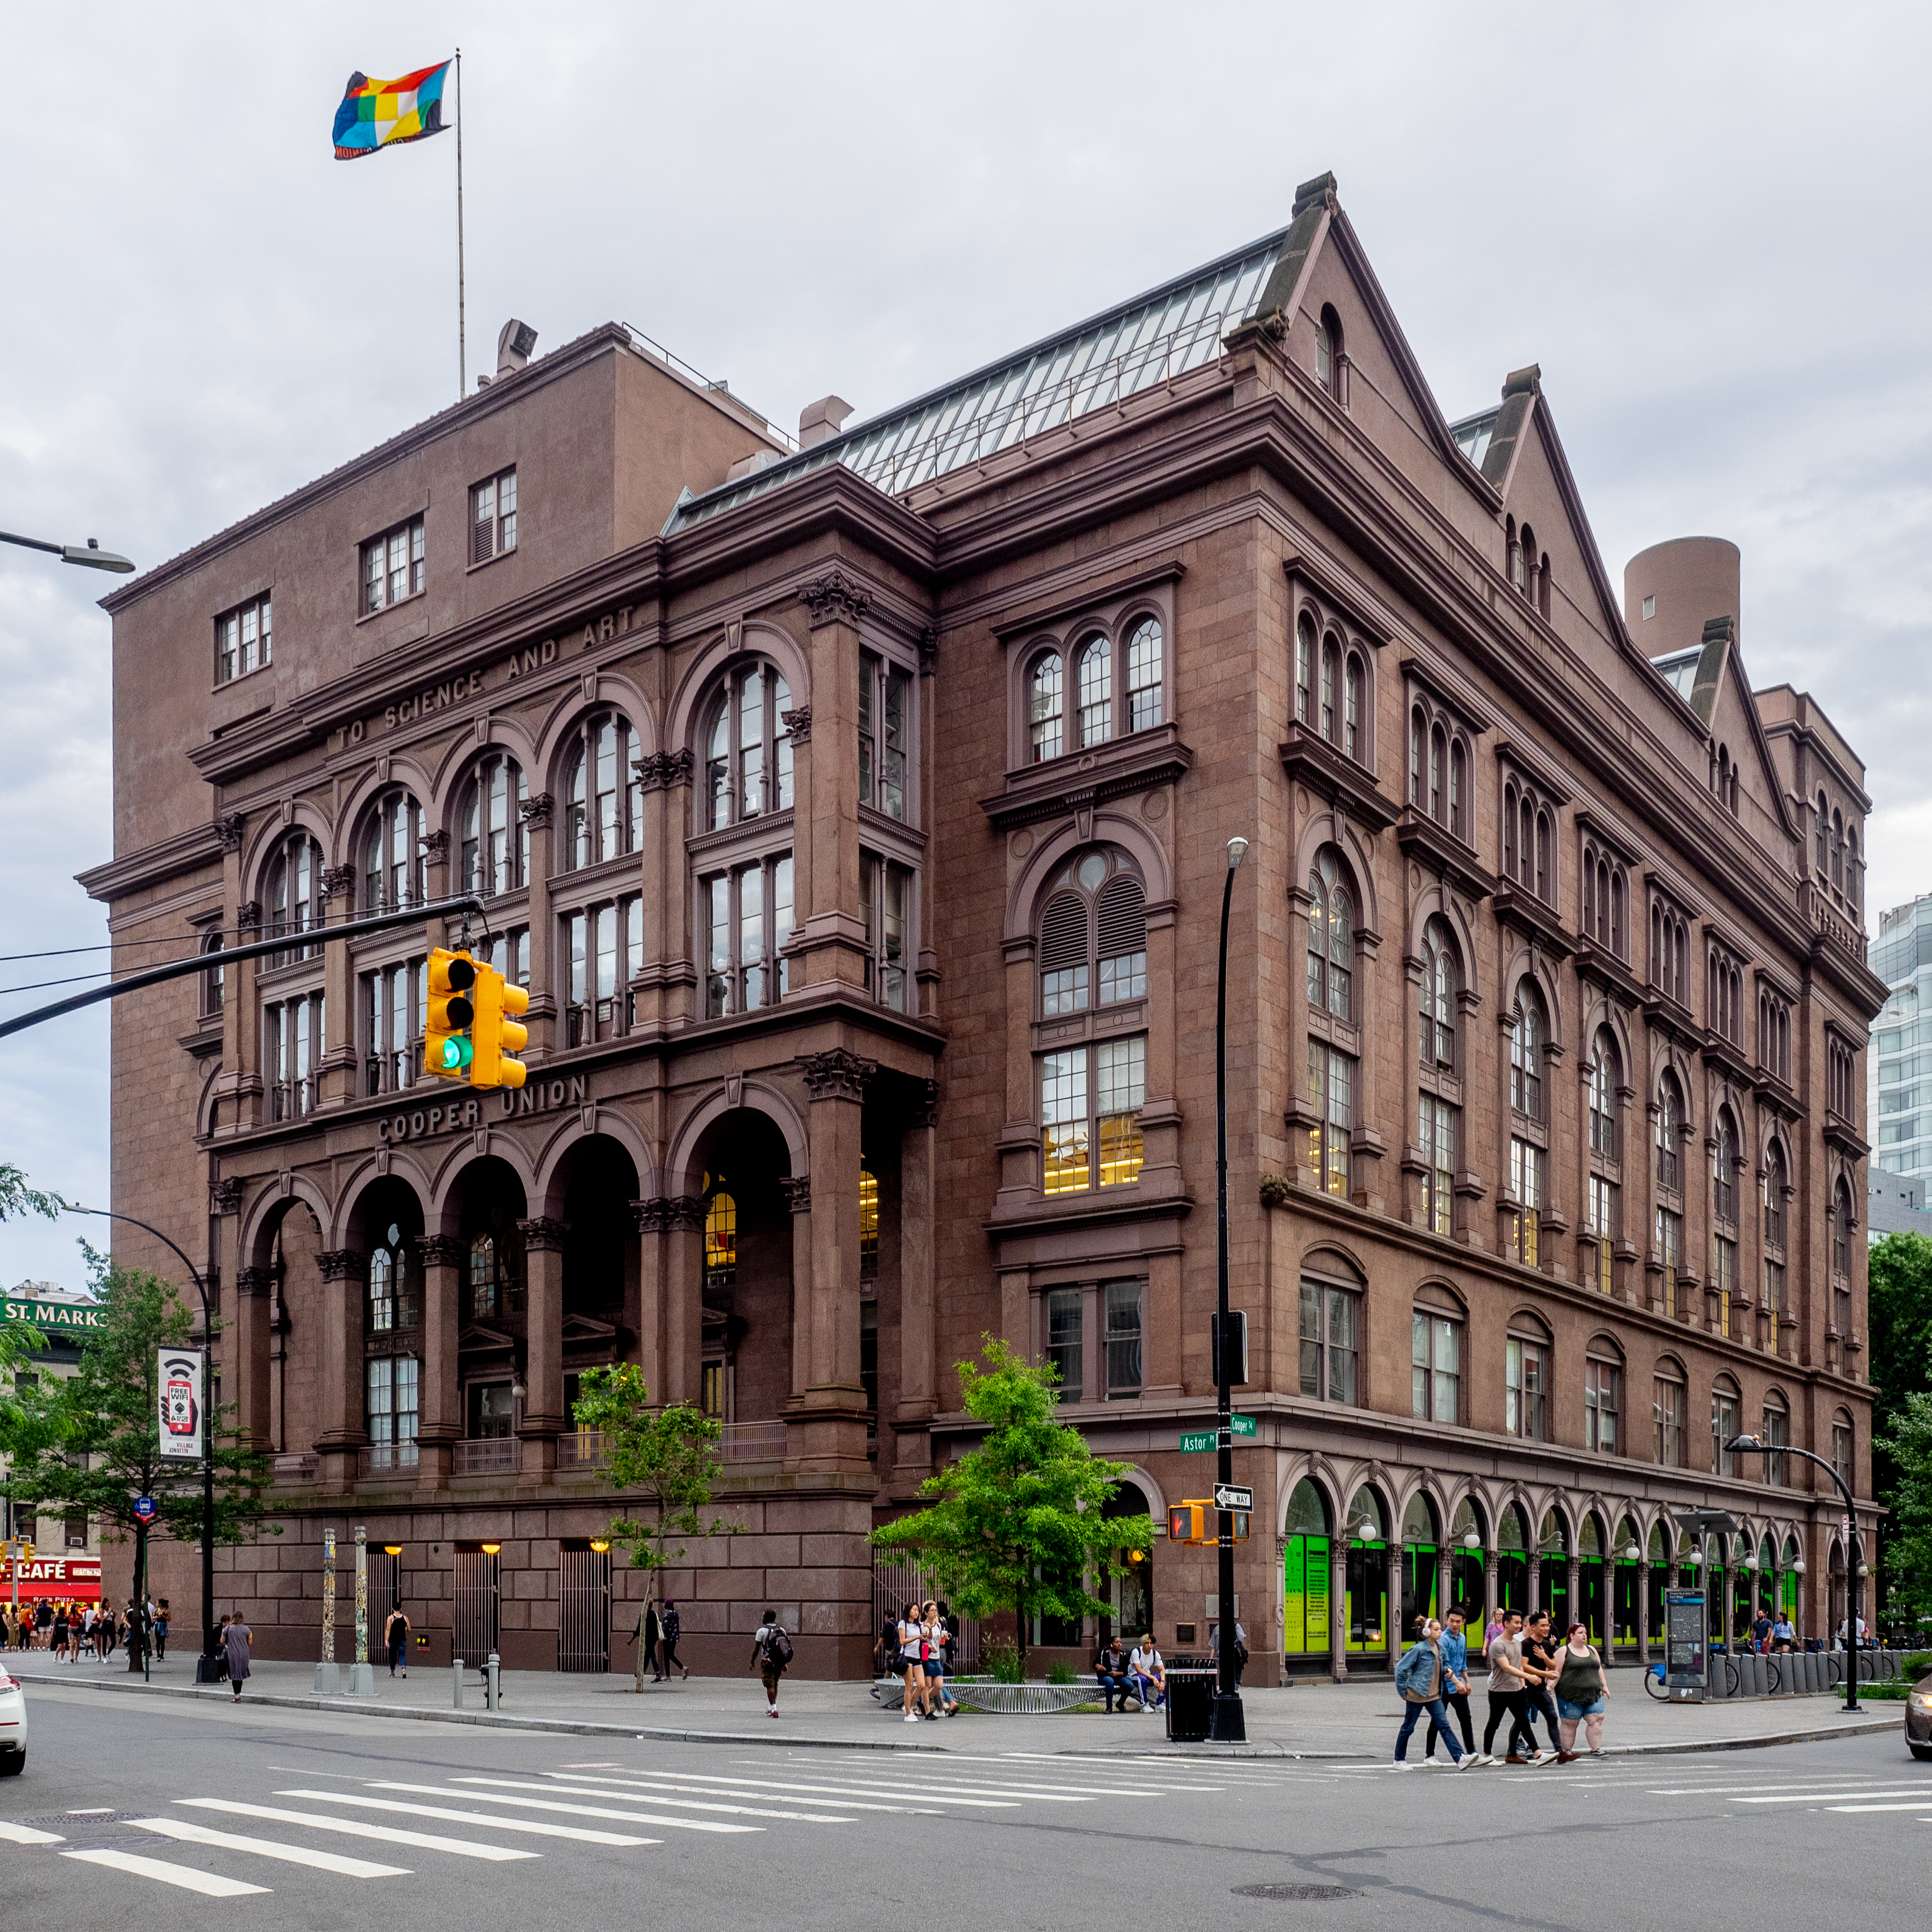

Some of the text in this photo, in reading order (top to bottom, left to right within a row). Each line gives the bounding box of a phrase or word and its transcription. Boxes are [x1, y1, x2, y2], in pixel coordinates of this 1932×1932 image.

[336, 718, 364, 749] TO
[385, 669, 484, 729] SCIENCE
[507, 638, 556, 680] AND
[377, 1074, 587, 1143] COOPER UNION
[5, 1303, 31, 1320] ST.
[1232, 1417, 1253, 1434] Cooper Sq
[1184, 1435, 1215, 1451] Astor Pl
[1220, 1492, 1248, 1504] ONE WAY
[17, 1560, 66, 1579] CAFÉ
